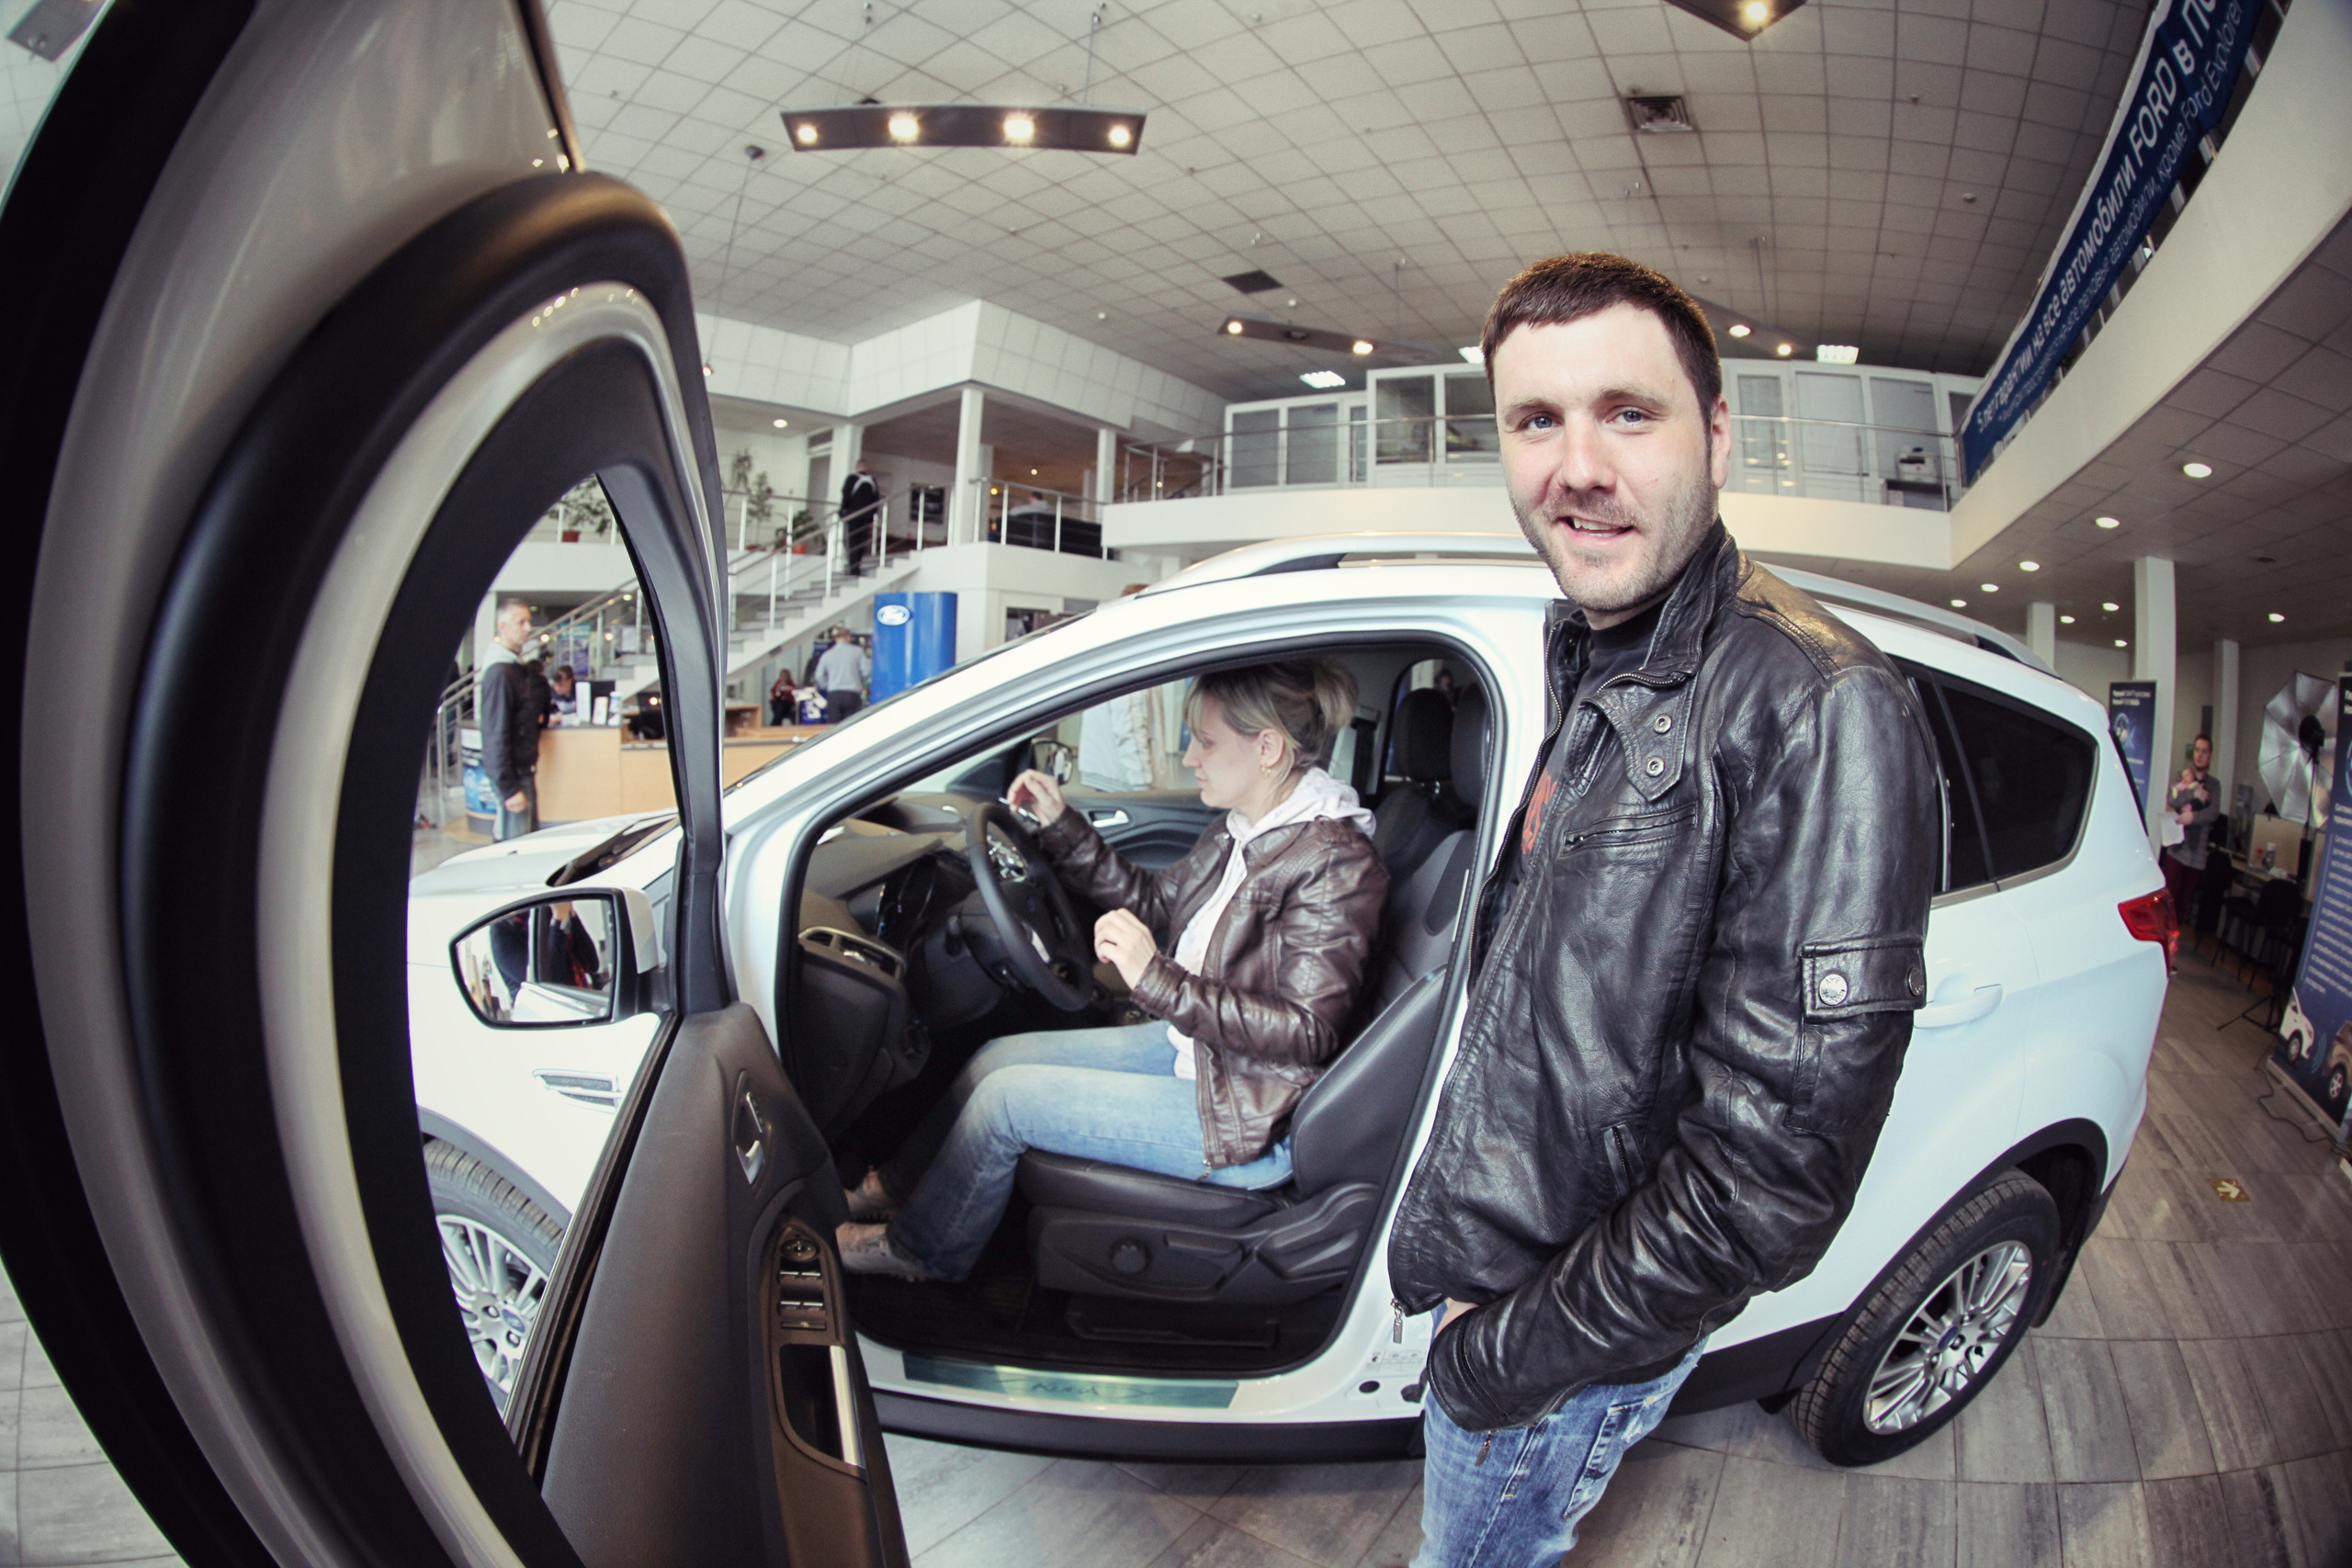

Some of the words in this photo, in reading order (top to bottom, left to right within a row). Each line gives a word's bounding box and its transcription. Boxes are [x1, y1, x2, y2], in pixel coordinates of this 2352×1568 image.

[1995, 344, 2034, 410] гарантии
[2031, 323, 2046, 356] на
[2042, 294, 2062, 336] все
[2059, 154, 2137, 306] автомобили
[2129, 57, 2177, 167] FORD
[2156, 121, 2188, 184] кроме
[2180, 76, 2213, 130] Ford
